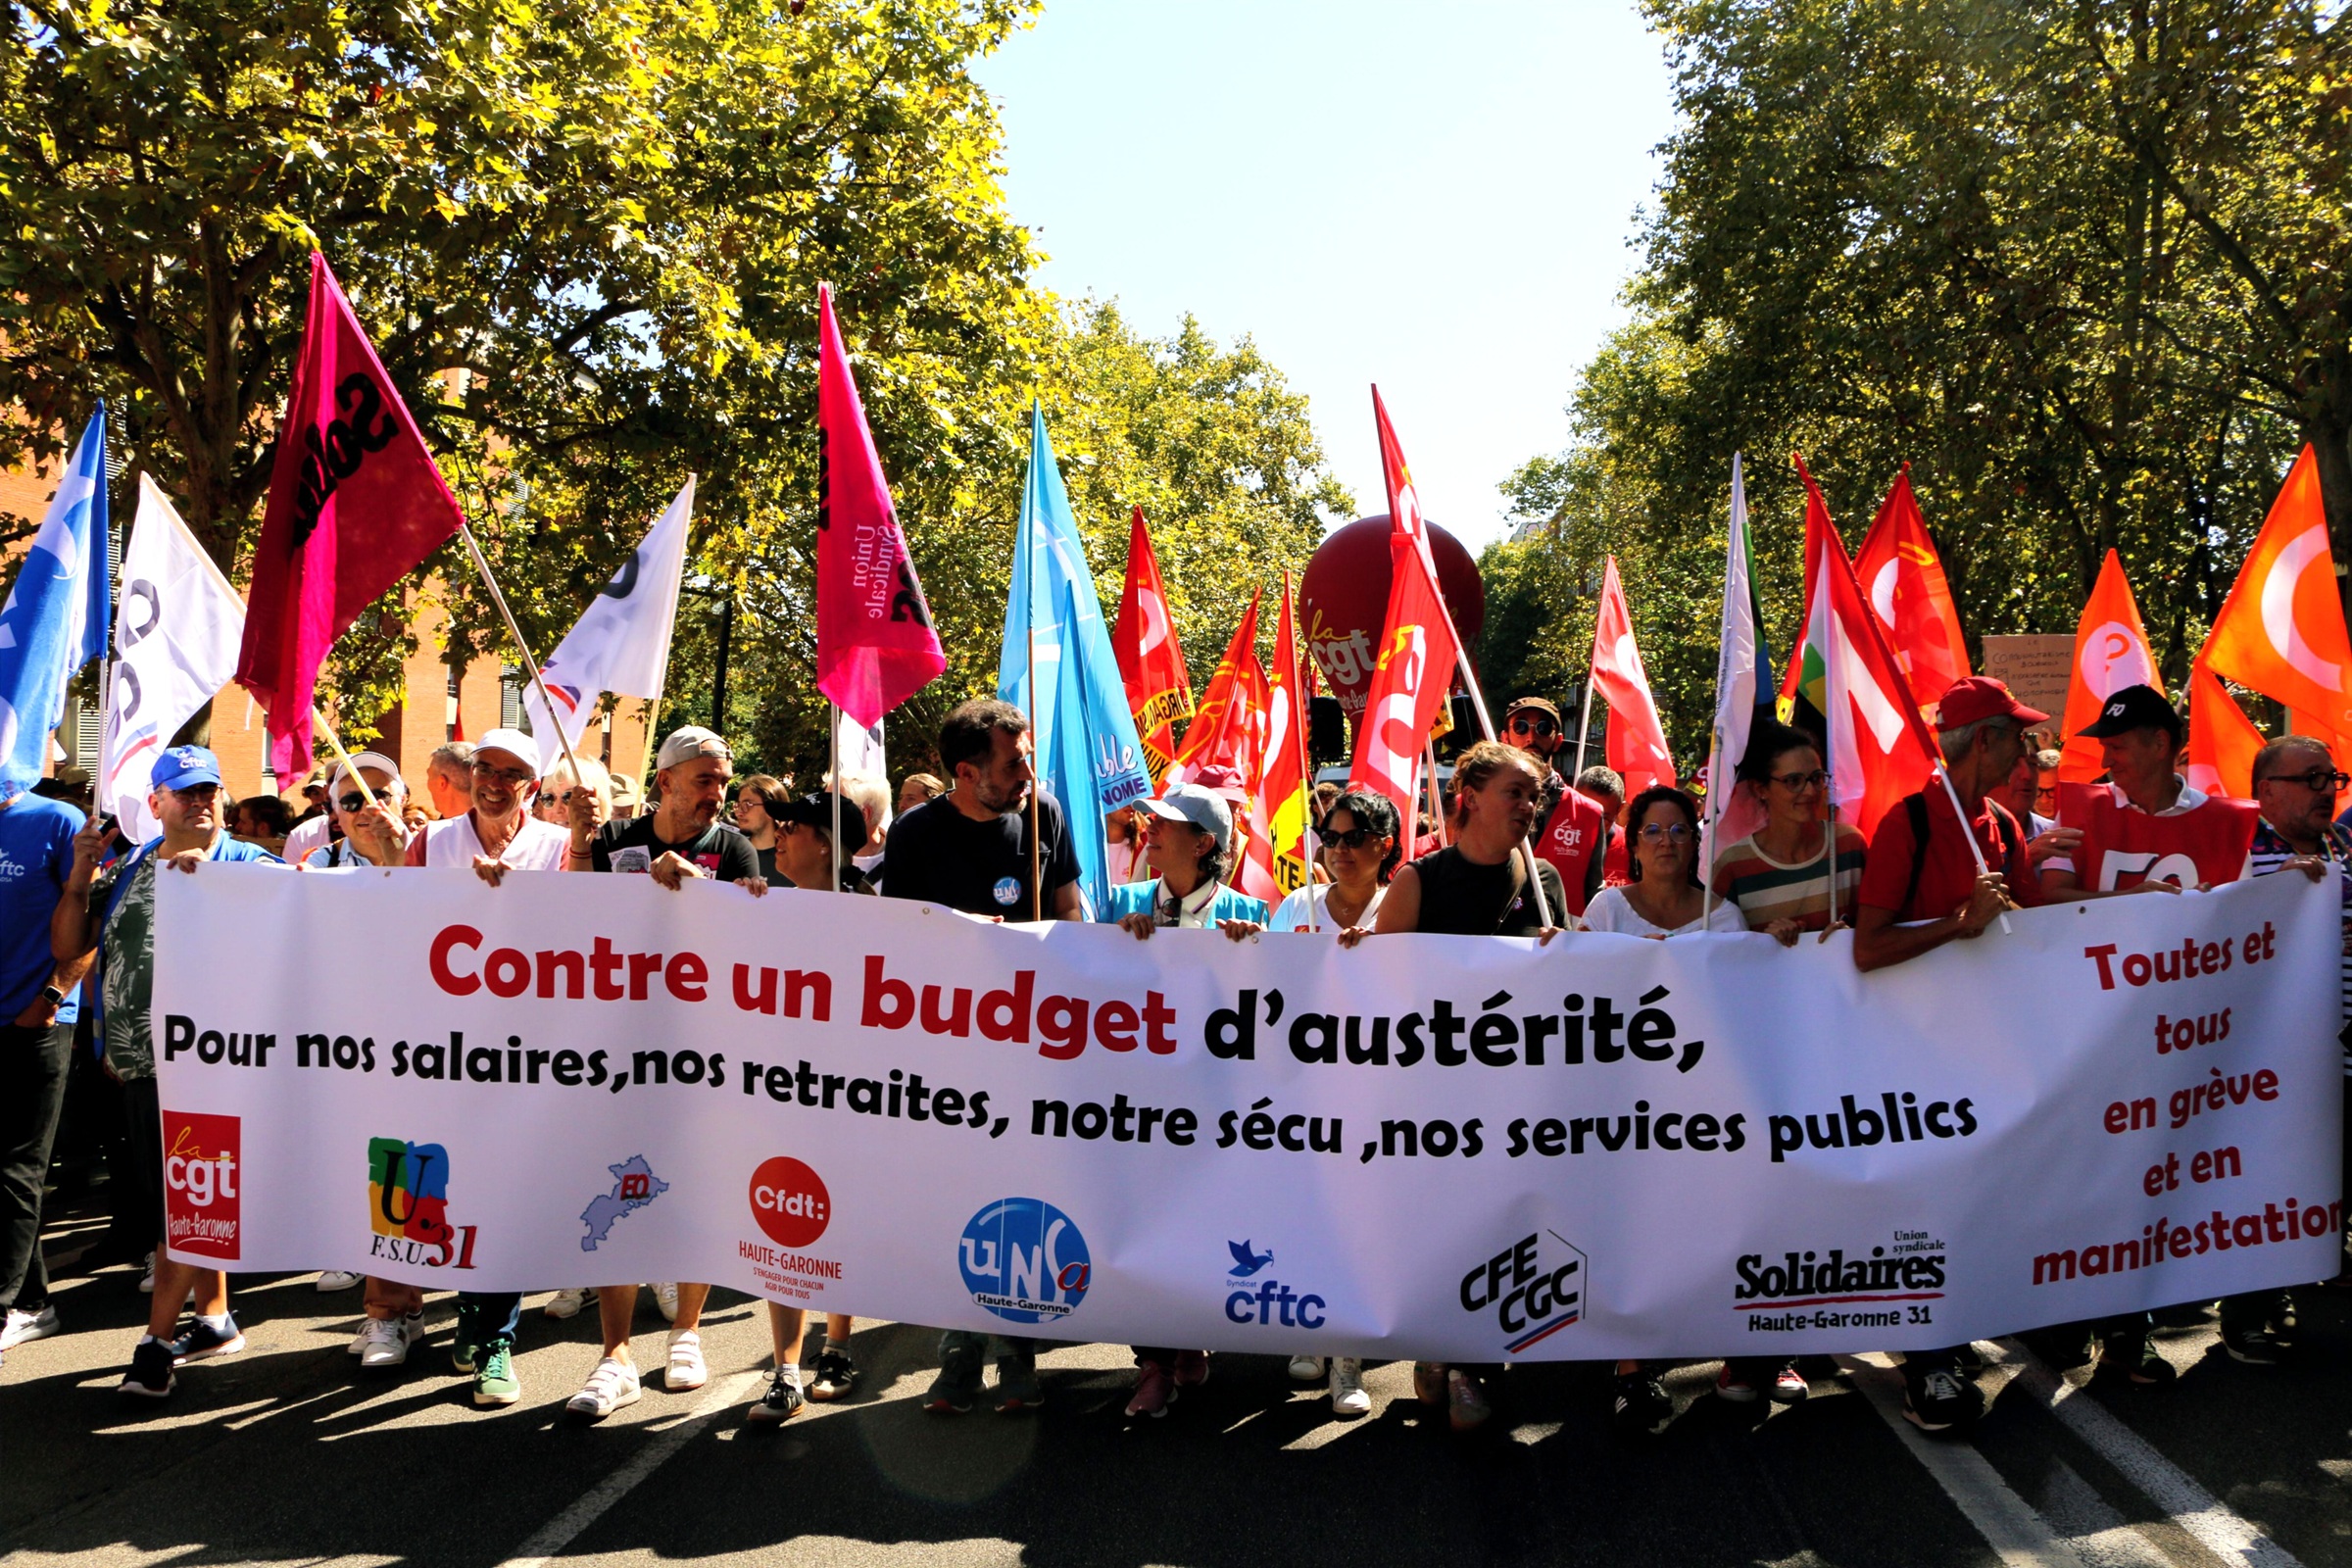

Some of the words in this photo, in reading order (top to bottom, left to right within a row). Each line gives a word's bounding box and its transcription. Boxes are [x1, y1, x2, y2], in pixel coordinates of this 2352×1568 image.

[1311, 629, 1377, 685] cgt
[2106, 703, 2127, 716] FO
[1102, 776, 1147, 807] NOME
[1553, 828, 1582, 846] cgt
[0, 859, 25, 877] ftc
[2084, 936, 2233, 991] Toutes
[2242, 921, 2276, 966] et
[429, 924, 710, 1003] Contre
[732, 962, 832, 1022] un
[859, 955, 1177, 1060] budget
[2155, 1006, 2231, 1054] tous
[164, 1014, 276, 1068] Pour
[296, 1032, 376, 1072] nos
[742, 1059, 1009, 1140] retraites,
[1031, 1094, 1199, 1150] notre
[1215, 1097, 1343, 1154] sécu
[1505, 1100, 1746, 1158] services
[1769, 1091, 1978, 1163] publics
[2103, 1094, 2157, 1135] en
[2169, 1066, 2280, 1129] grève
[169, 1126, 234, 1160] la
[166, 1151, 236, 1206] cgt
[620, 1173, 650, 1201] FO
[2142, 1152, 2180, 1198] et
[2190, 1145, 2242, 1186] en
[169, 1211, 237, 1241] Haute-Garonne
[1893, 1229, 1929, 1242] Union
[739, 1240, 843, 1280] HAUTE-GARONNE
[1892, 1239, 1946, 1254] syndicale
[764, 1281, 778, 1293] AGIR
[778, 1285, 794, 1297] POUR
[795, 1289, 810, 1299] TOUS
[782, 1275, 799, 1287] POUR
[799, 1279, 824, 1291] CHACUN
[1459, 1232, 1538, 1312] CFE
[1735, 1246, 1946, 1300] Solidaires
[976, 1293, 1071, 1315] Haute-Garonne
[1224, 1280, 1327, 1329] cftc
[1497, 1260, 1579, 1334] CGC
[1747, 1308, 1901, 1333] Haute-Garonne
[1907, 1305, 1933, 1325] 31
